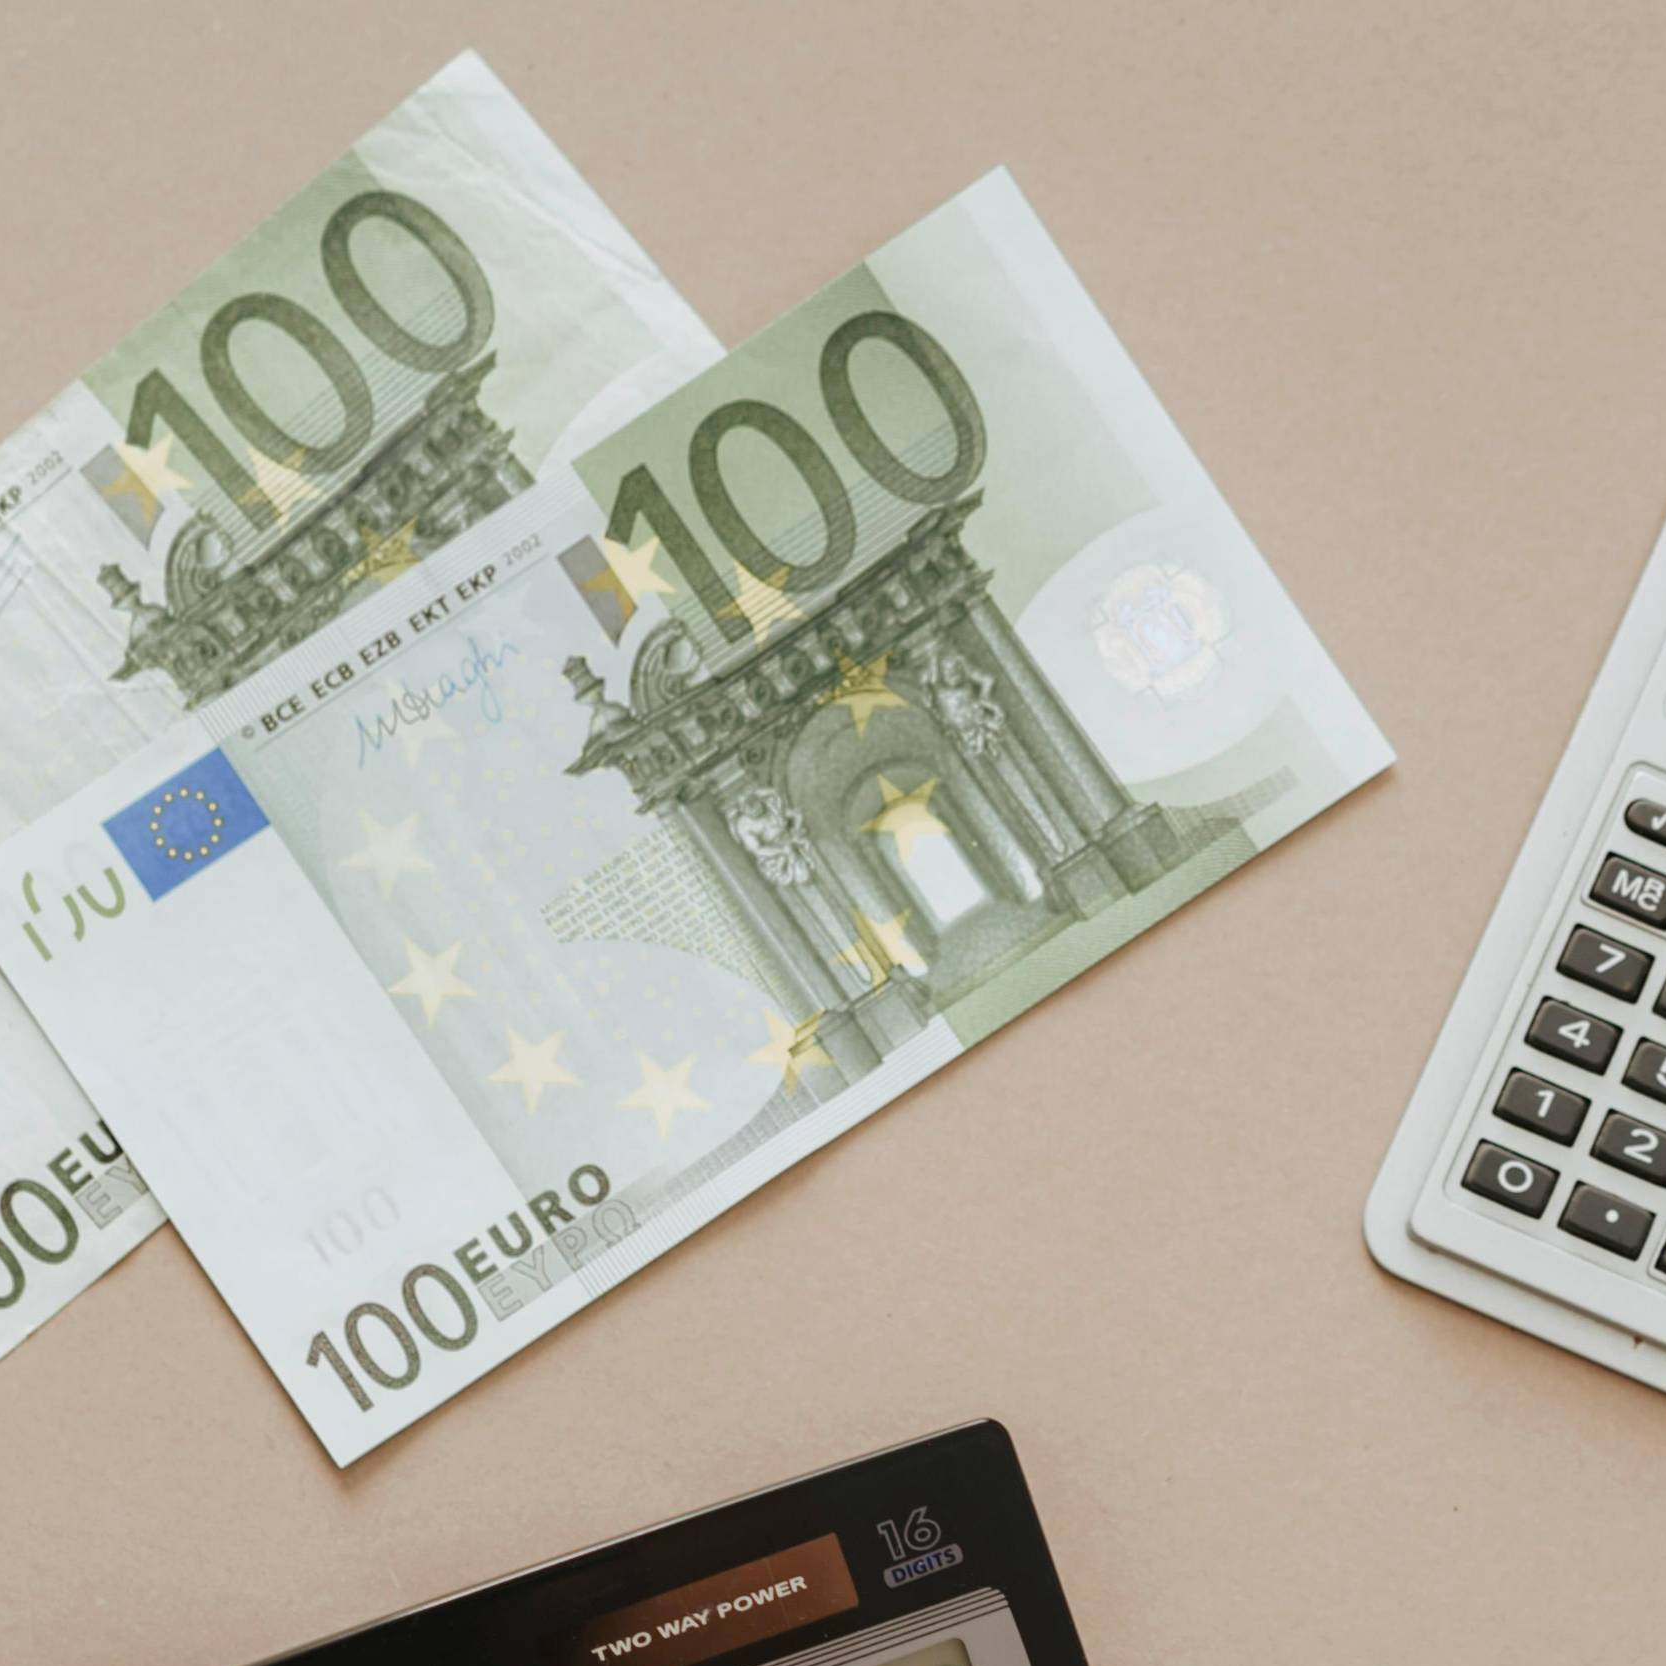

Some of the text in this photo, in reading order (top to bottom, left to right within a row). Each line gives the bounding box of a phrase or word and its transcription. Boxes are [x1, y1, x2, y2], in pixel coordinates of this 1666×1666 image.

[124, 189, 496, 535] 100
[26, 450, 64, 487] 2002
[603, 309, 988, 645] 100
[259, 692, 306, 735] BCE
[310, 661, 355, 700] ECB
[358, 630, 403, 668] EZB
[406, 594, 451, 634] EKT
[455, 563, 499, 603] EKP
[500, 533, 544, 567] 2002
[1593, 943, 1627, 974] 7
[1557, 1019, 1592, 1049] 4
[1532, 1088, 1557, 1118] 1
[46, 1117, 126, 1194] EU
[1623, 1129, 1660, 1163] 2
[1496, 1161, 1533, 1194] 0
[304, 1162, 612, 1413] 100 EURO
[877, 1506, 943, 1561] 16
[891, 1548, 957, 1586] DIGITS
[590, 1574, 808, 1663] TWO WAY POWER
